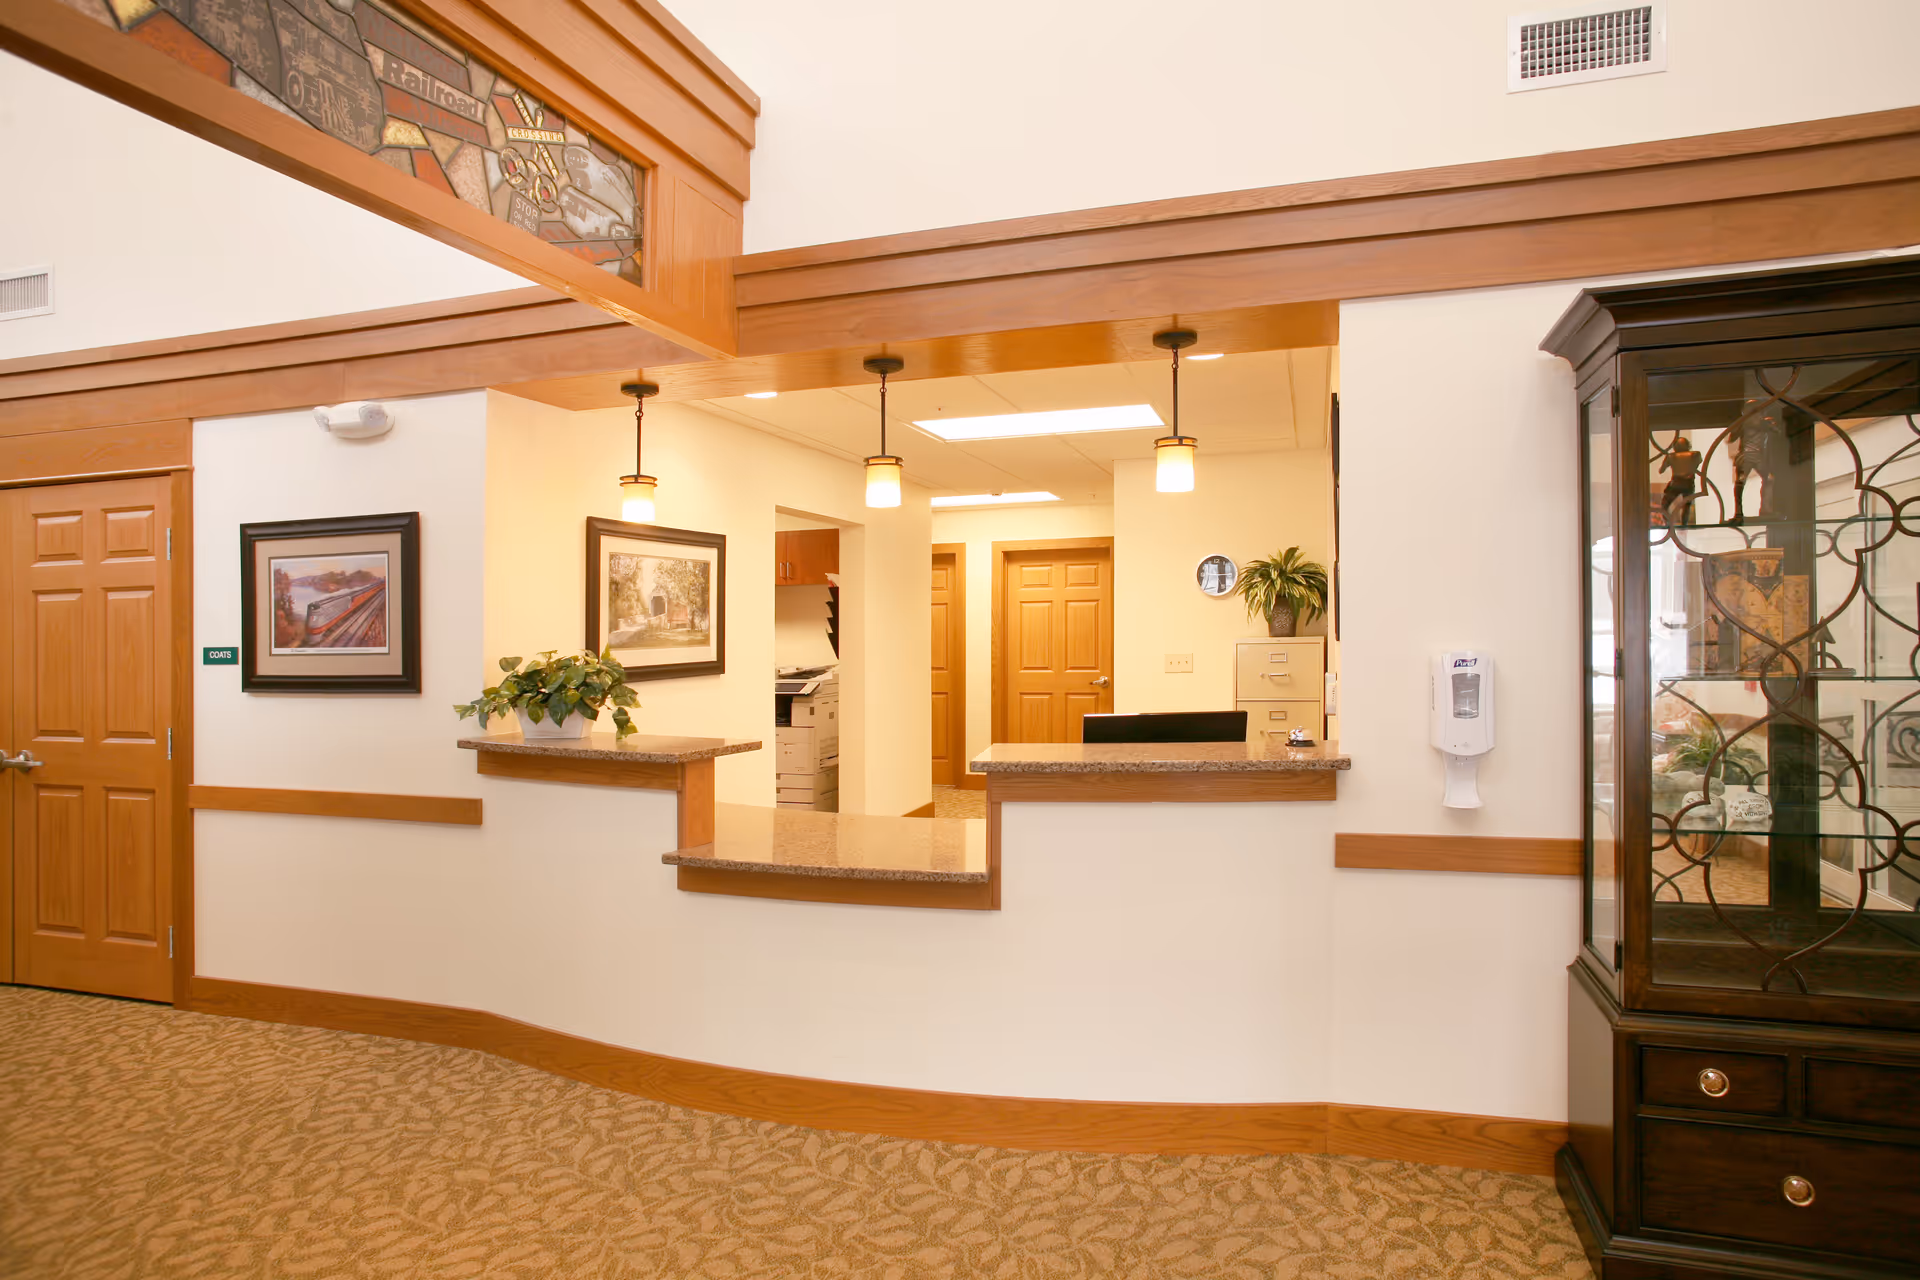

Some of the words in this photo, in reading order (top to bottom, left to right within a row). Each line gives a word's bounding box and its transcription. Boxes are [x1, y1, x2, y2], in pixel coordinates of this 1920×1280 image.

[383, 53, 478, 118] Railroad
[511, 128, 562, 142] CROSSING
[516, 197, 538, 219] STOP
[514, 211, 523, 221] ON
[524, 218, 536, 231] RED
[209, 650, 232, 659] COATS
